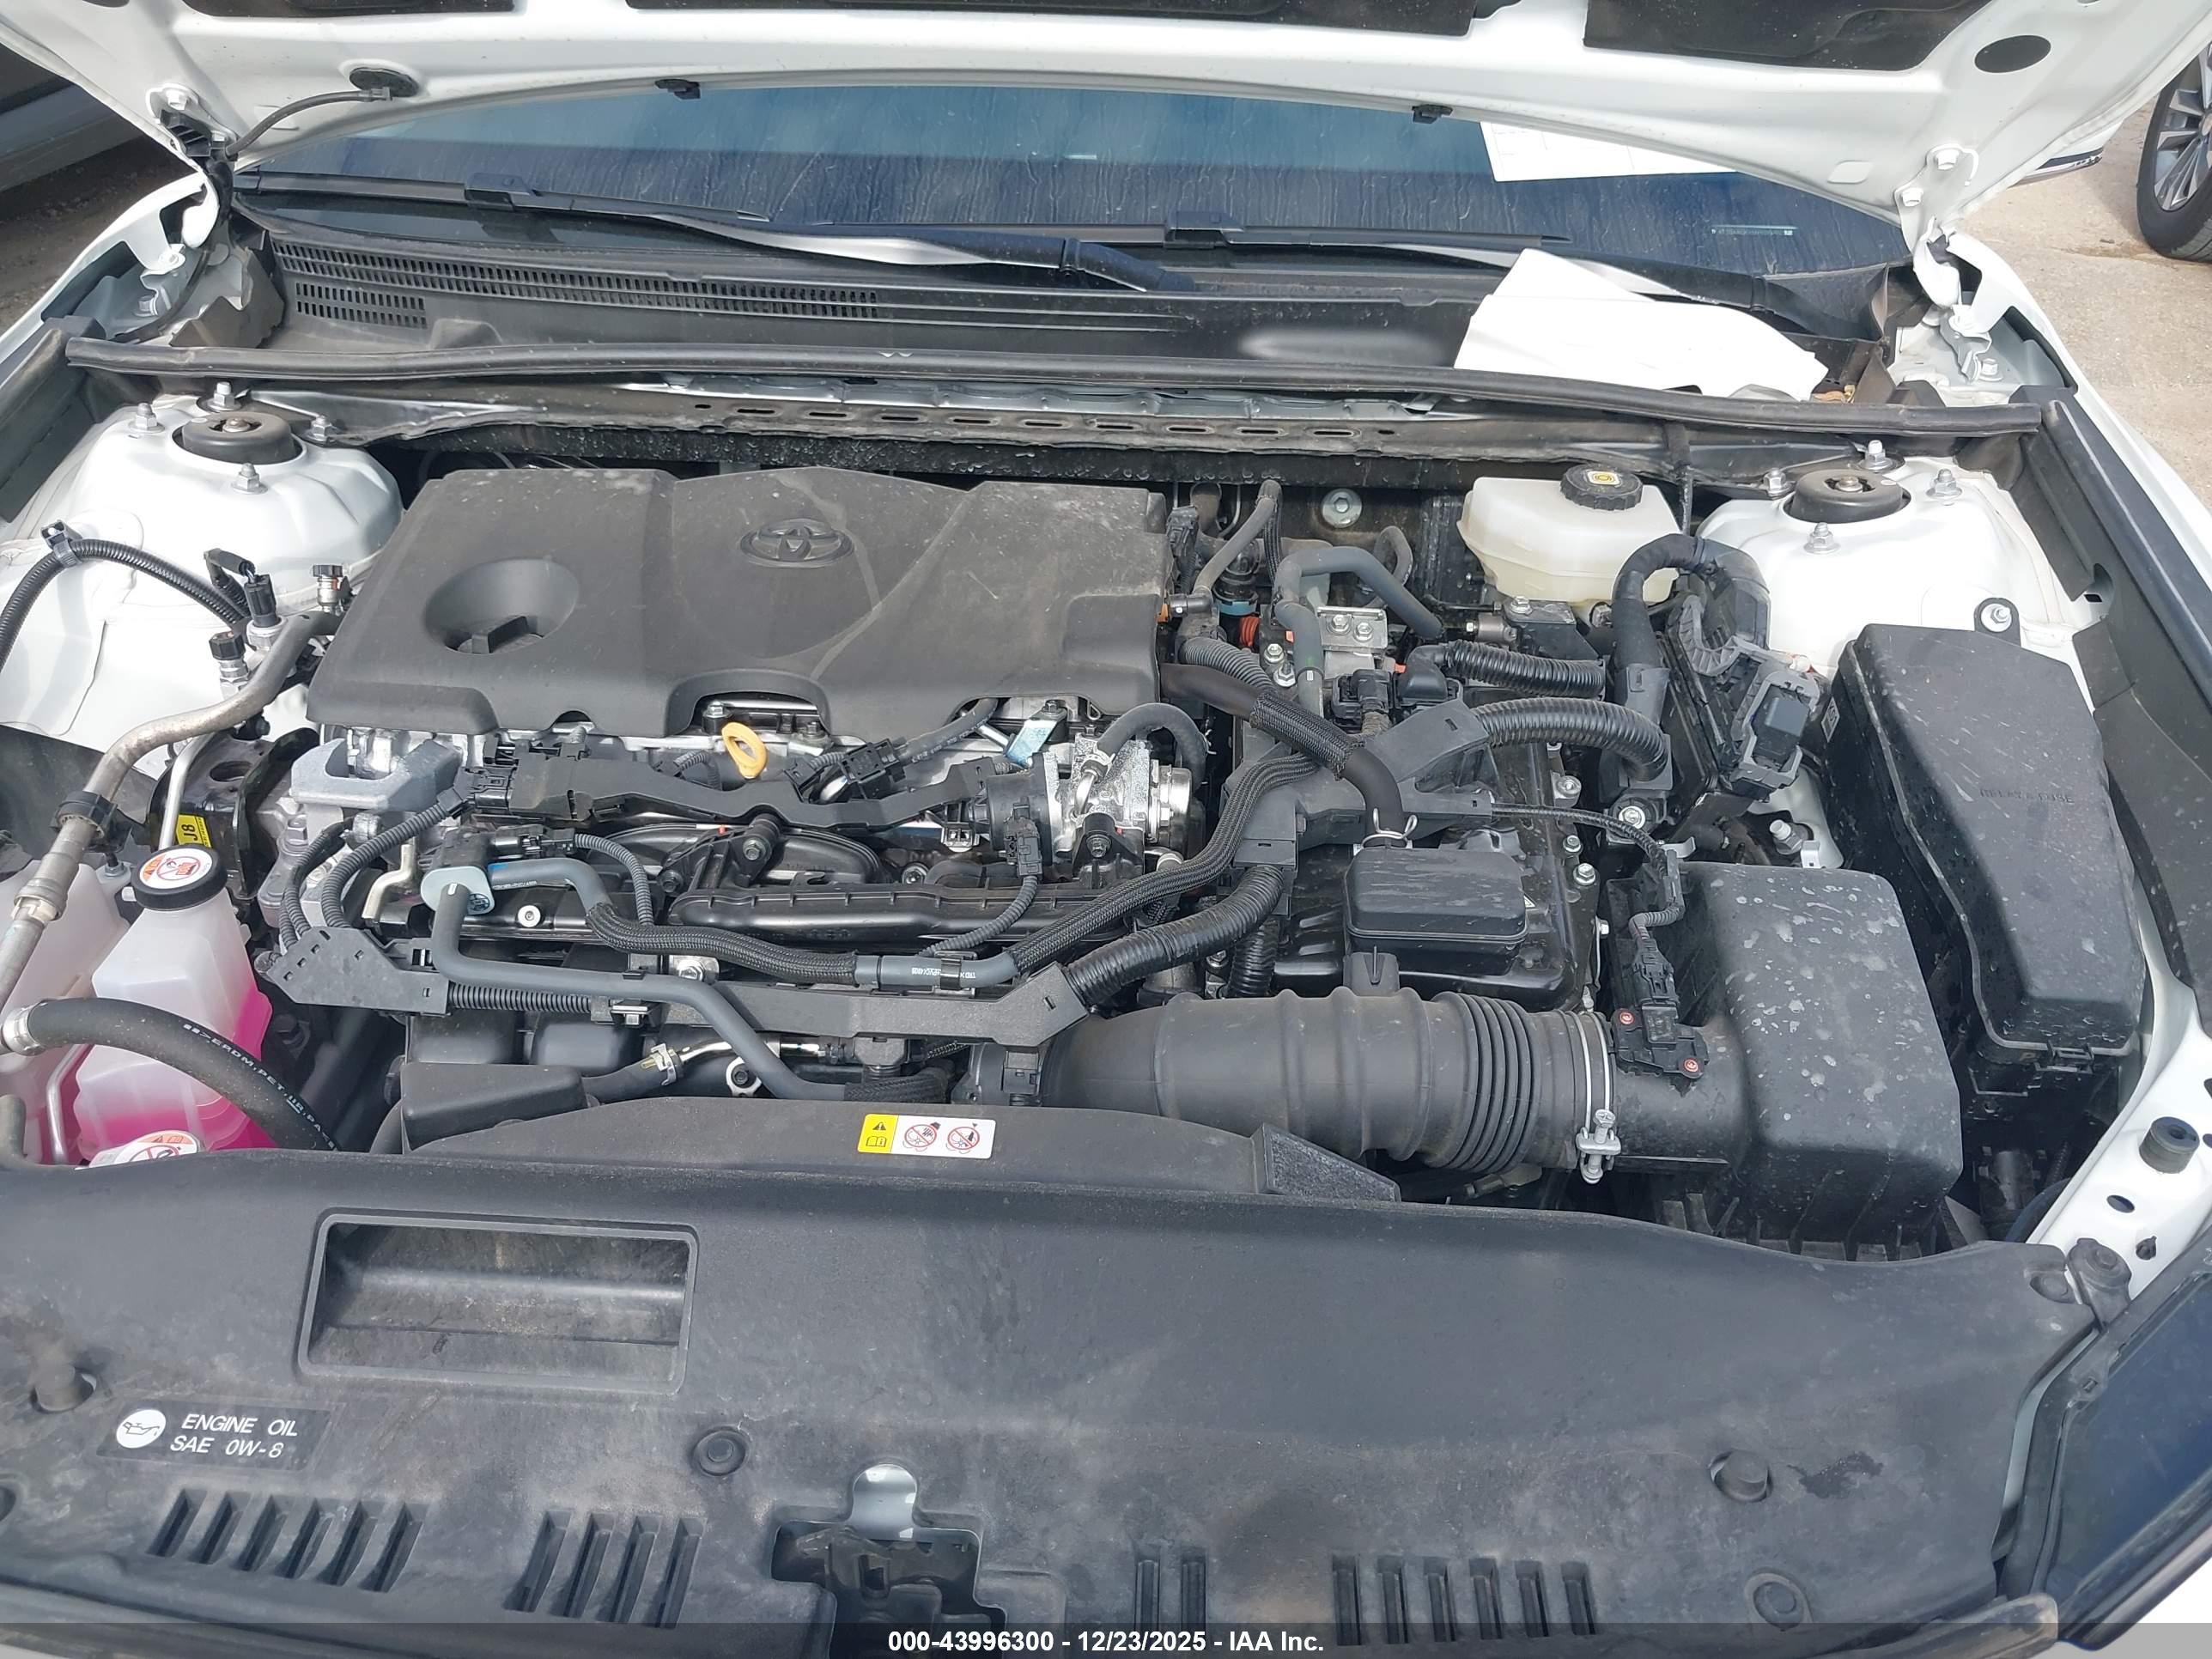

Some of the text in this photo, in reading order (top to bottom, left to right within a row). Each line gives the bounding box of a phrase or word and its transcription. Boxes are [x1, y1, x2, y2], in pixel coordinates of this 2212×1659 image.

[182, 1413, 298, 1437] ENGINE OIL
[170, 1435, 284, 1458] SAE 0W-8
